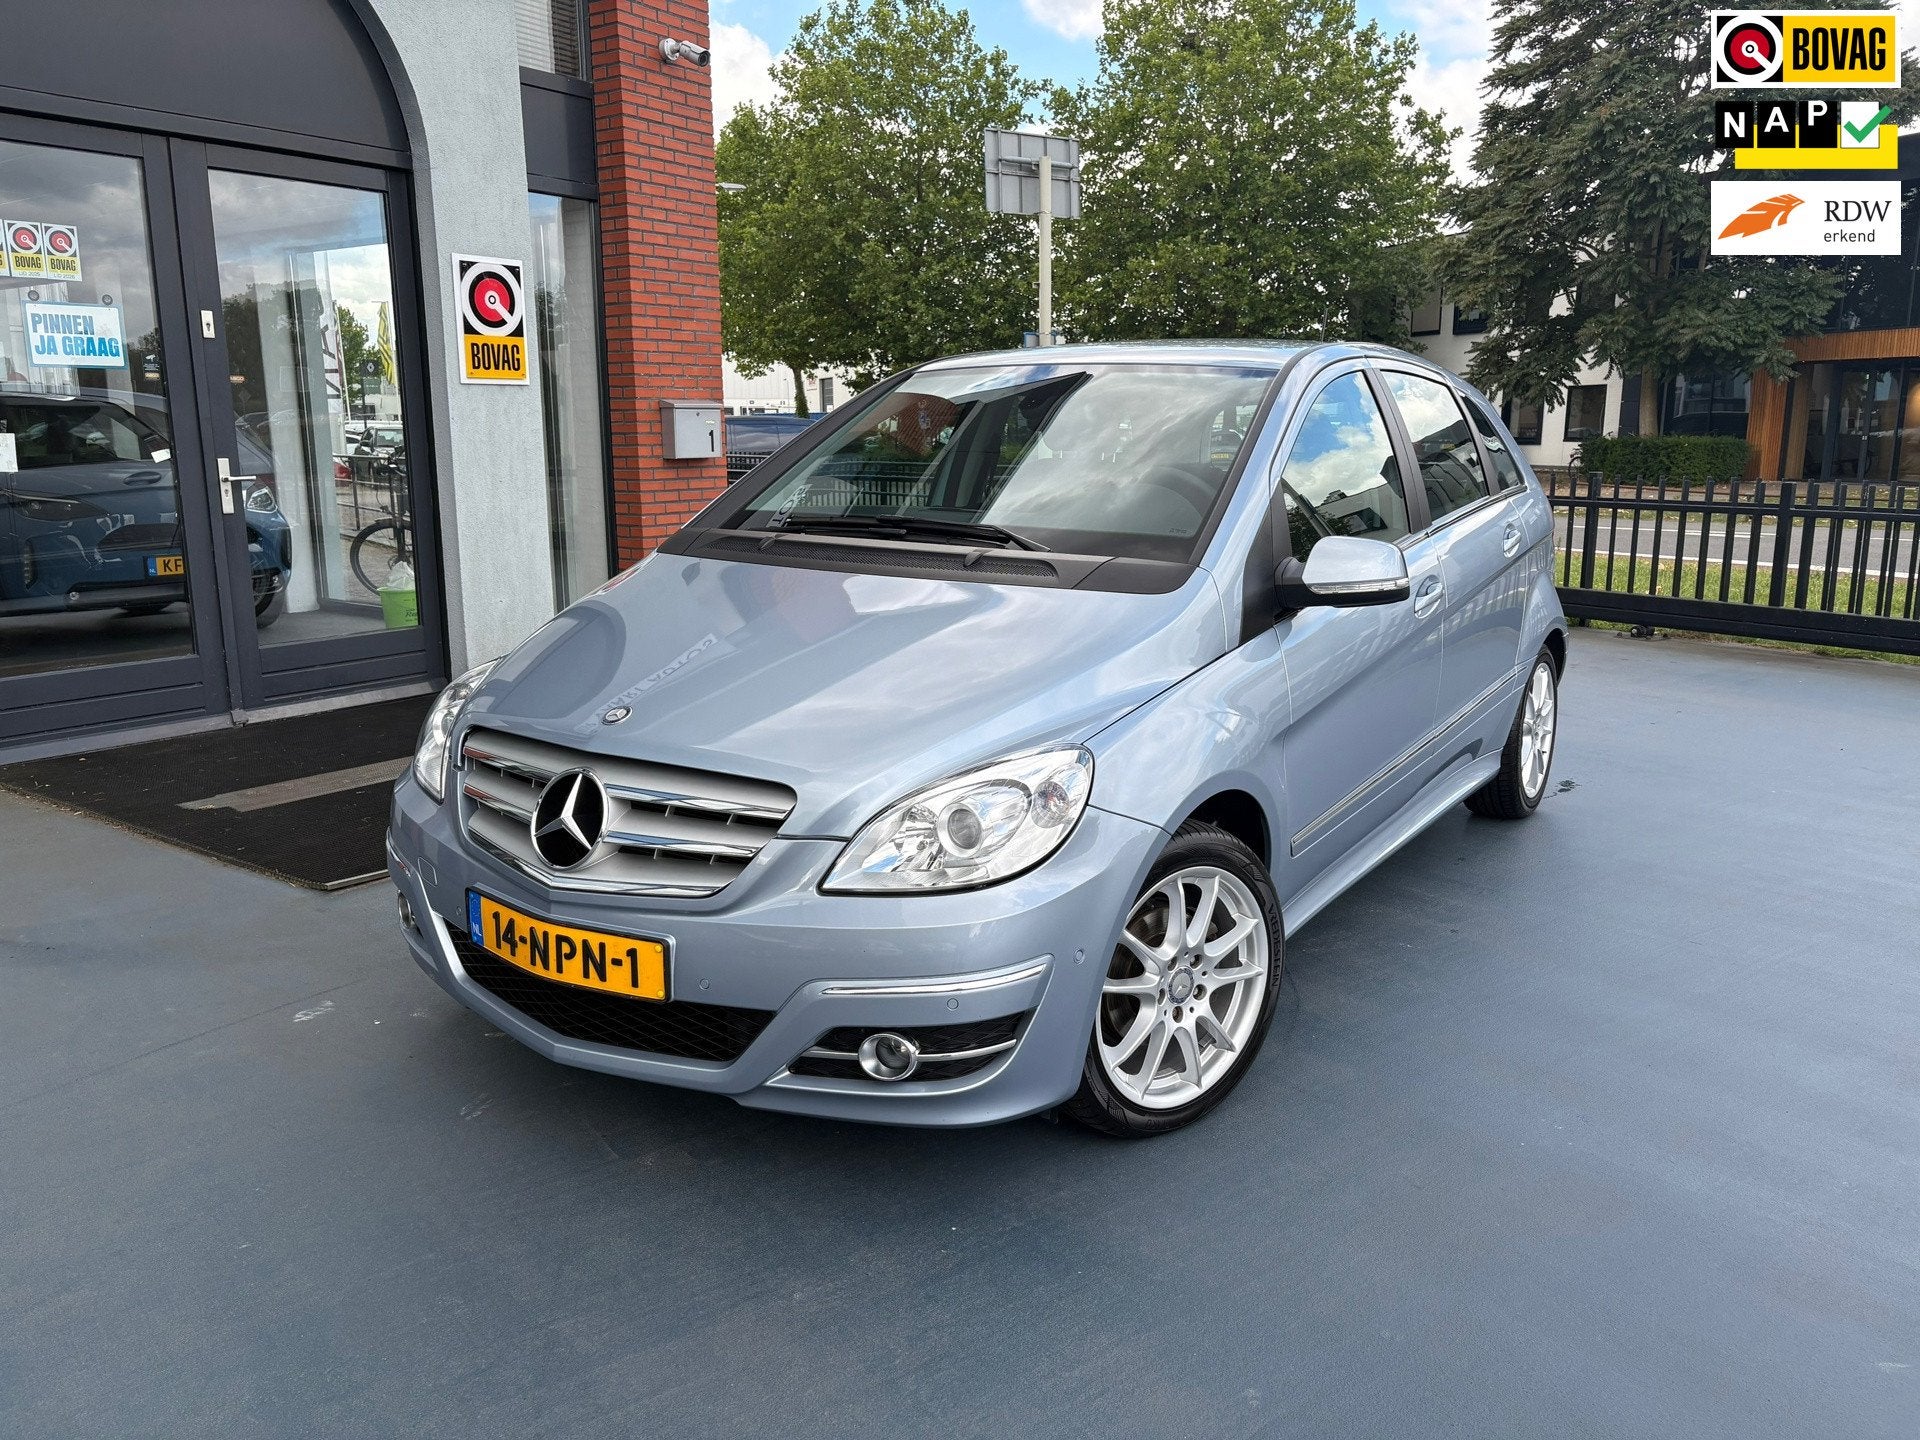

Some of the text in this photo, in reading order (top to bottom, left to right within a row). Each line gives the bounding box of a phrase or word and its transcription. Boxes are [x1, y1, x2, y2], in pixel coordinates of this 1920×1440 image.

[14, 255, 42, 269] BOVAG
[50, 258, 76, 272] BOVAG
[31, 313, 94, 335] PINNEN
[35, 335, 120, 357] JA GRAAG
[470, 342, 521, 372] BOVAG
[708, 429, 715, 453] 1
[492, 910, 639, 989] 14-NPN-1
